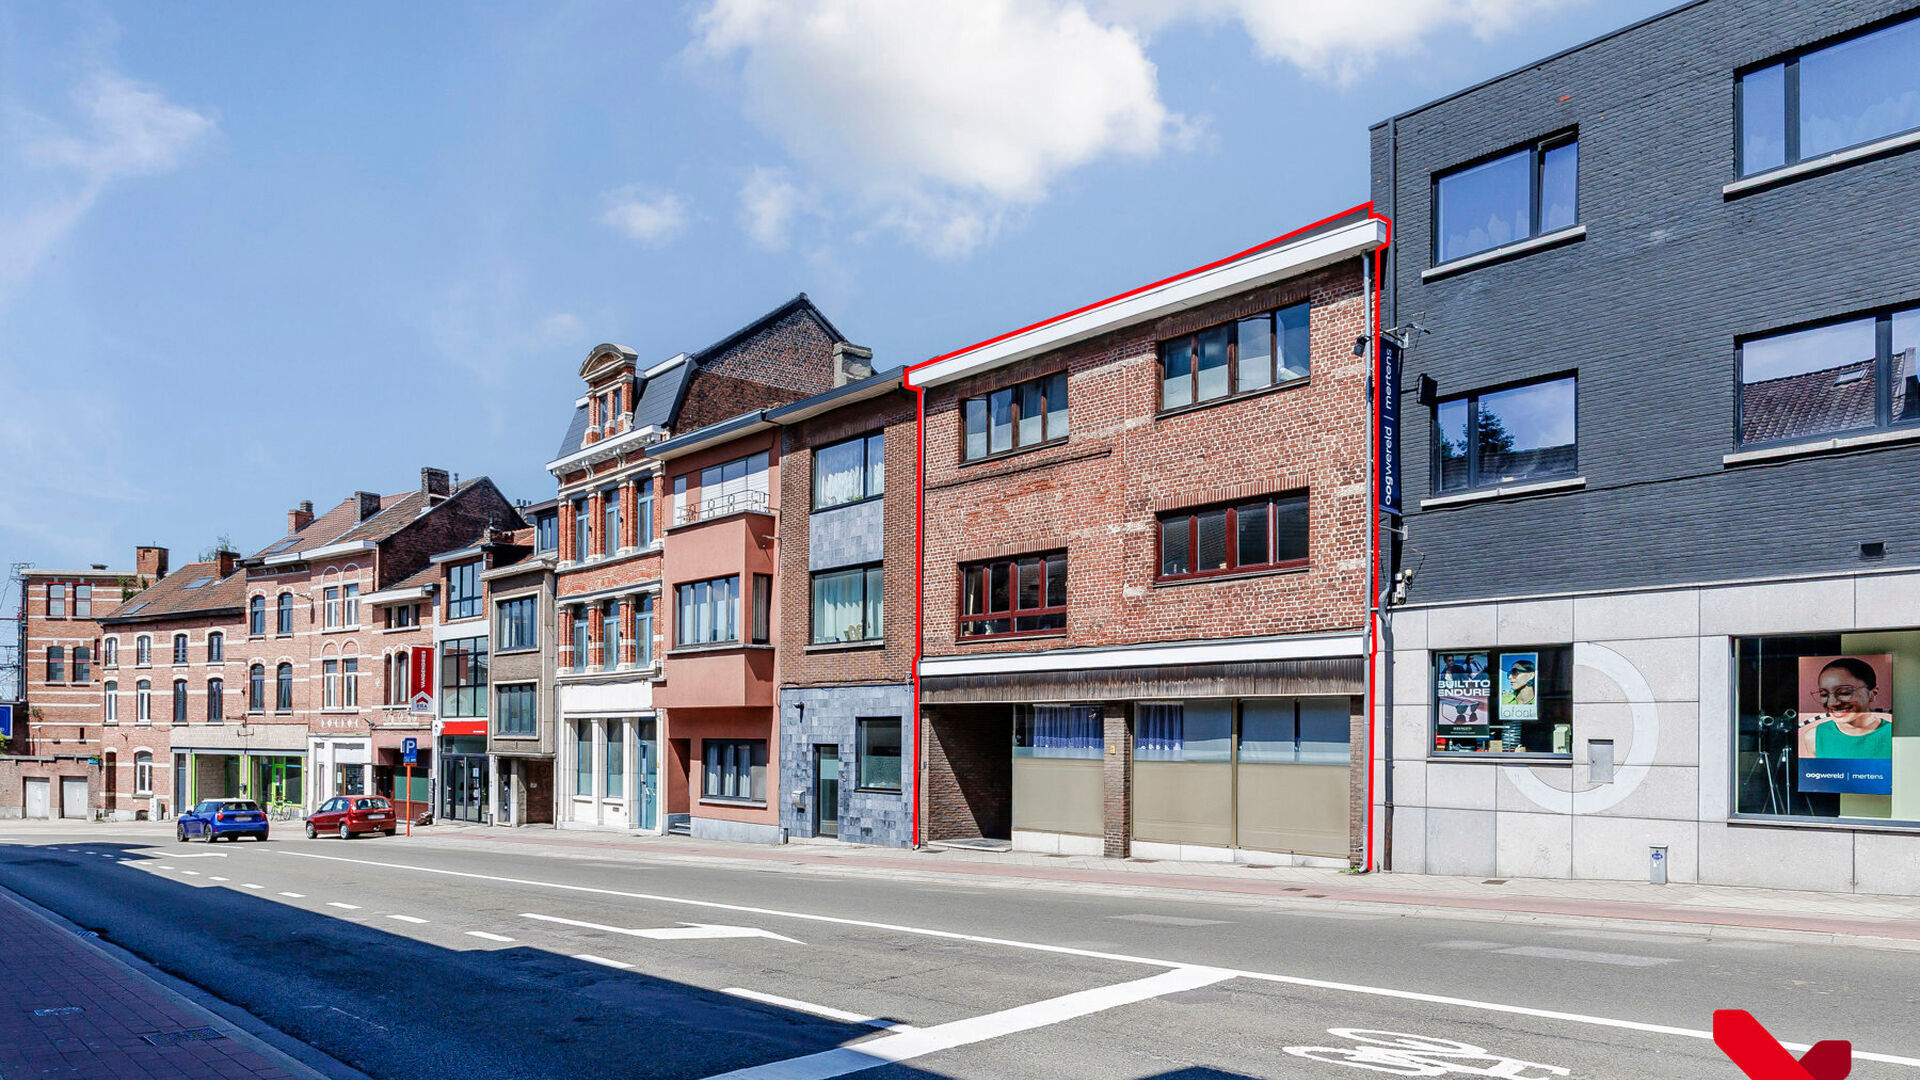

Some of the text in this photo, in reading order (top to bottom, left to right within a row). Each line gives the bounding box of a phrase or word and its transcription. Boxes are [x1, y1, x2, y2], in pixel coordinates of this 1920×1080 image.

[1384, 348, 1394, 506] oogwereld mertens
[1438, 680, 1491, 689] BUILT TO
[1438, 688, 1490, 697] ENDURE
[406, 740, 416, 754] P
[1805, 772, 1845, 780] oogwereld
